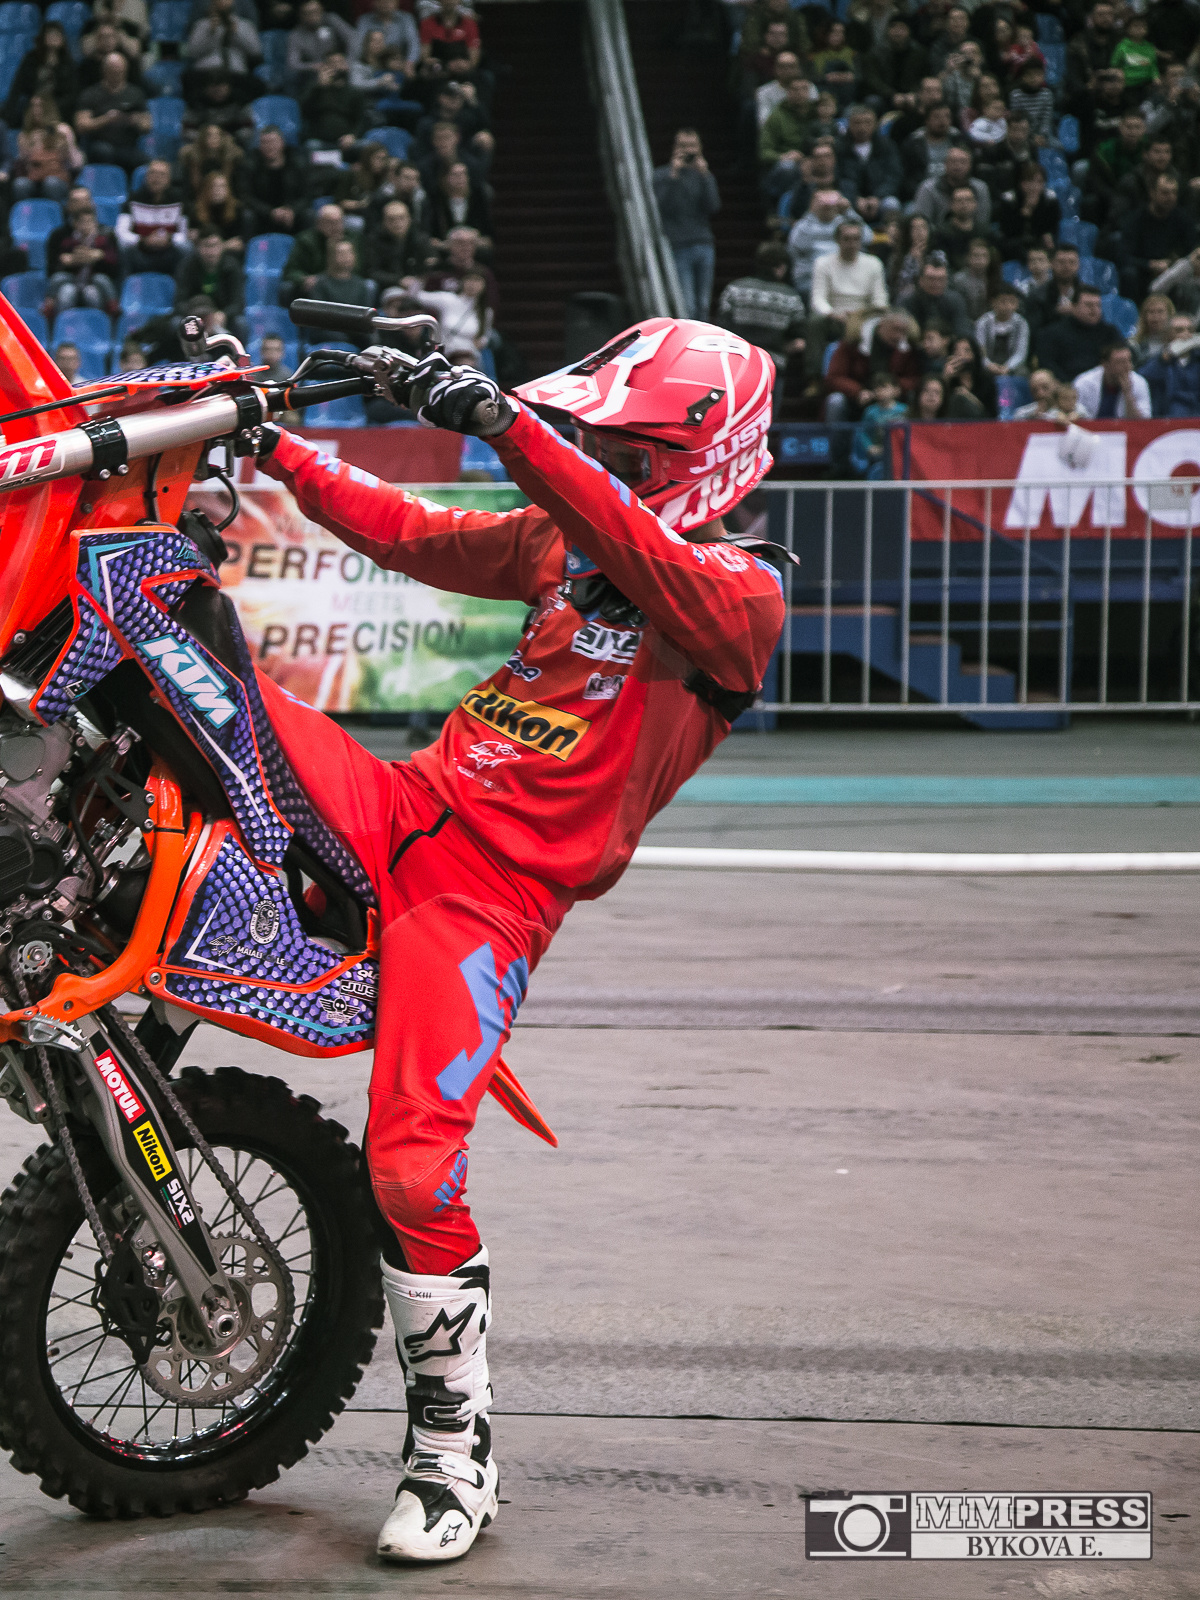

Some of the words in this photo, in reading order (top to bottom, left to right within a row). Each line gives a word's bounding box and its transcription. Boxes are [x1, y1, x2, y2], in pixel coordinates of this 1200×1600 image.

[259, 618, 466, 660] PRECISION
[136, 633, 239, 729] KTM
[96, 1056, 141, 1119] MOTUL
[137, 1127, 166, 1176] Nikon
